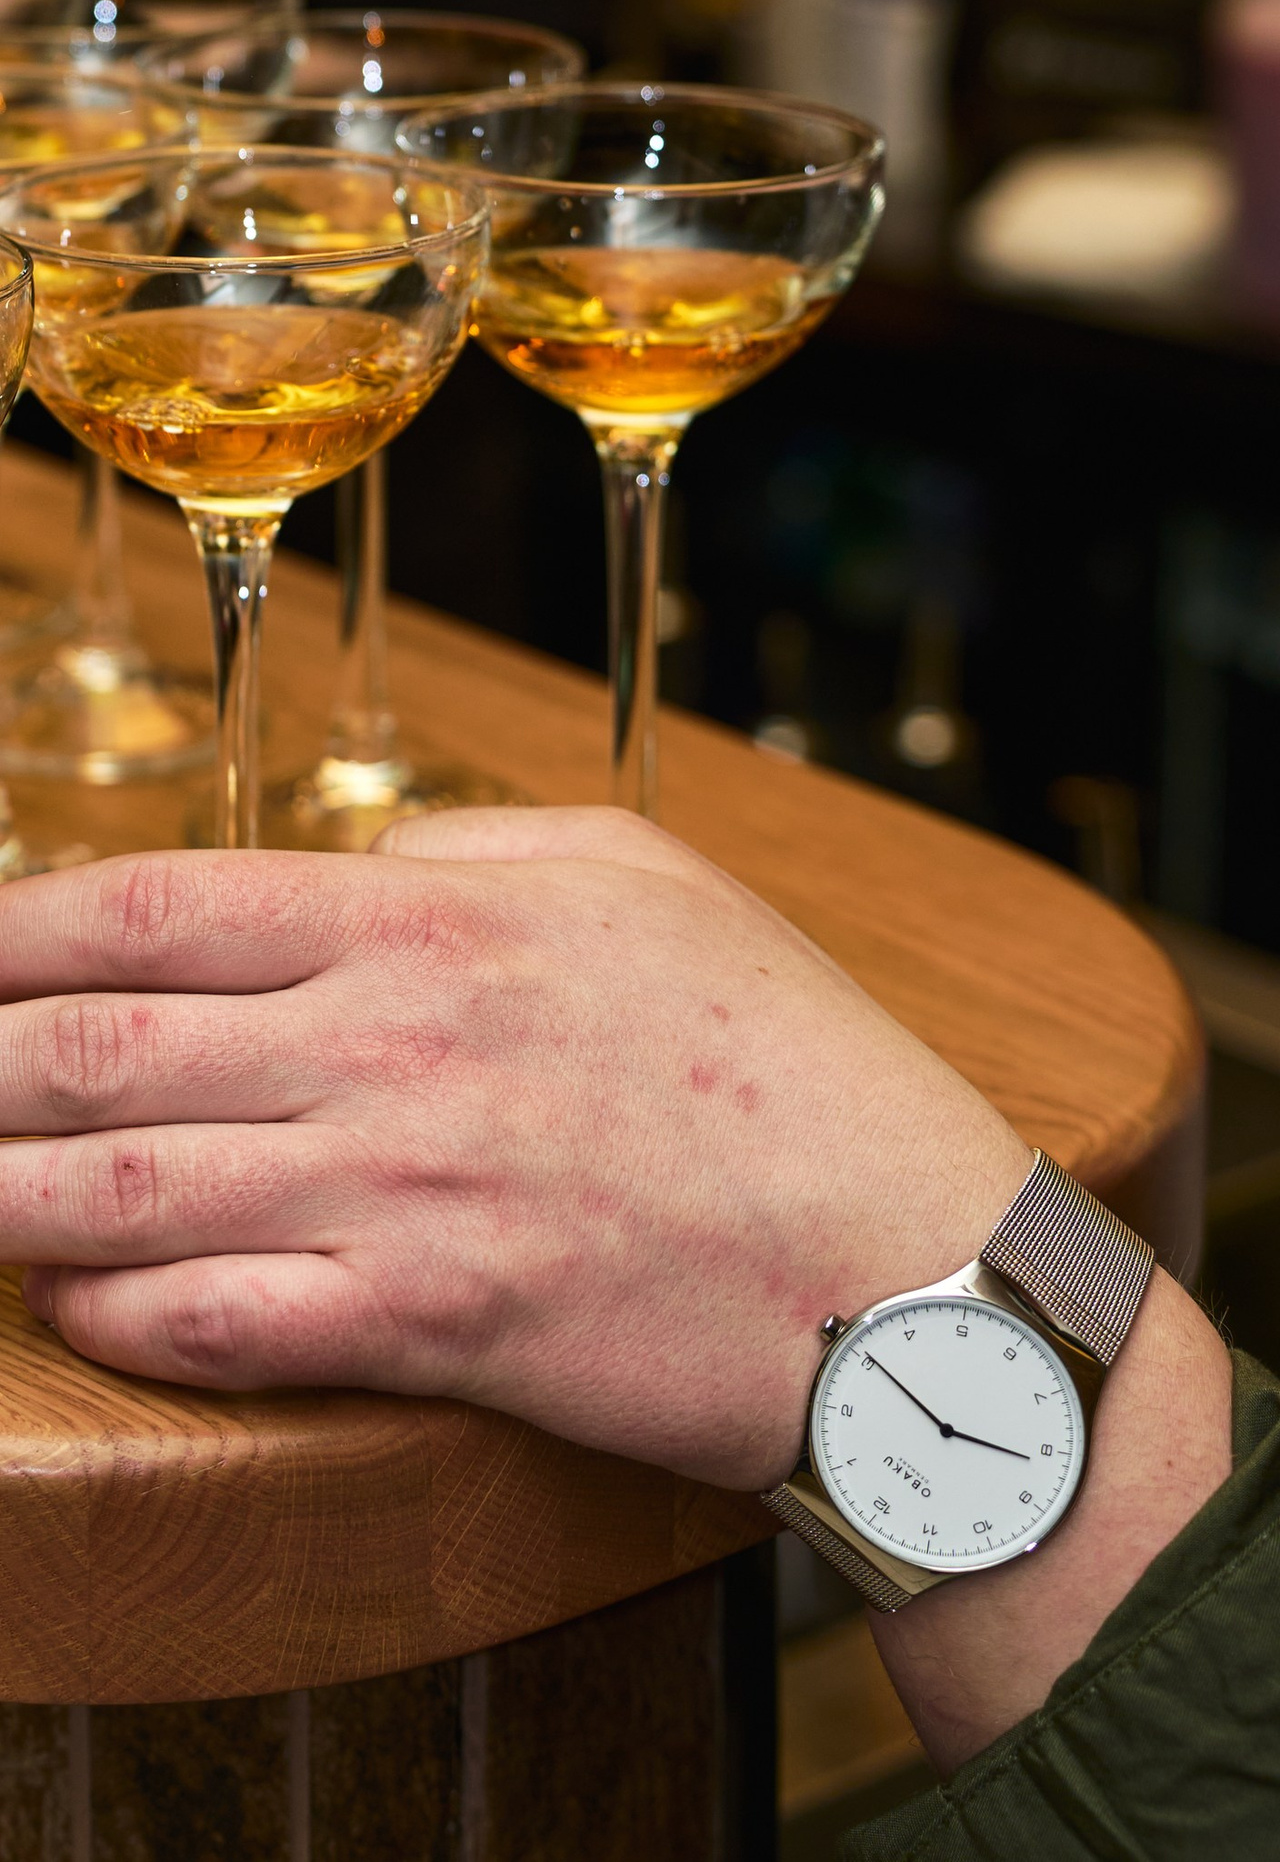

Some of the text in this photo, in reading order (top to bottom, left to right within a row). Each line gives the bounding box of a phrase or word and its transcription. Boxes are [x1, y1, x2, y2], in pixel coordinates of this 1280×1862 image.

[903, 1328, 916, 1342] 4
[956, 1324, 969, 1338] 5
[1003, 1346, 1017, 1361] 6
[861, 1355, 875, 1371] 3
[1033, 1392, 1048, 1406] 7
[840, 1403, 854, 1418] 2
[1040, 1443, 1053, 1457] 8
[846, 1457, 857, 1467] 1
[883, 1455, 931, 1498] OBAKU
[873, 1495, 891, 1515] 12
[1019, 1490, 1033, 1505] 9
[922, 1523, 938, 1536] 11
[973, 1519, 993, 1535] 10
